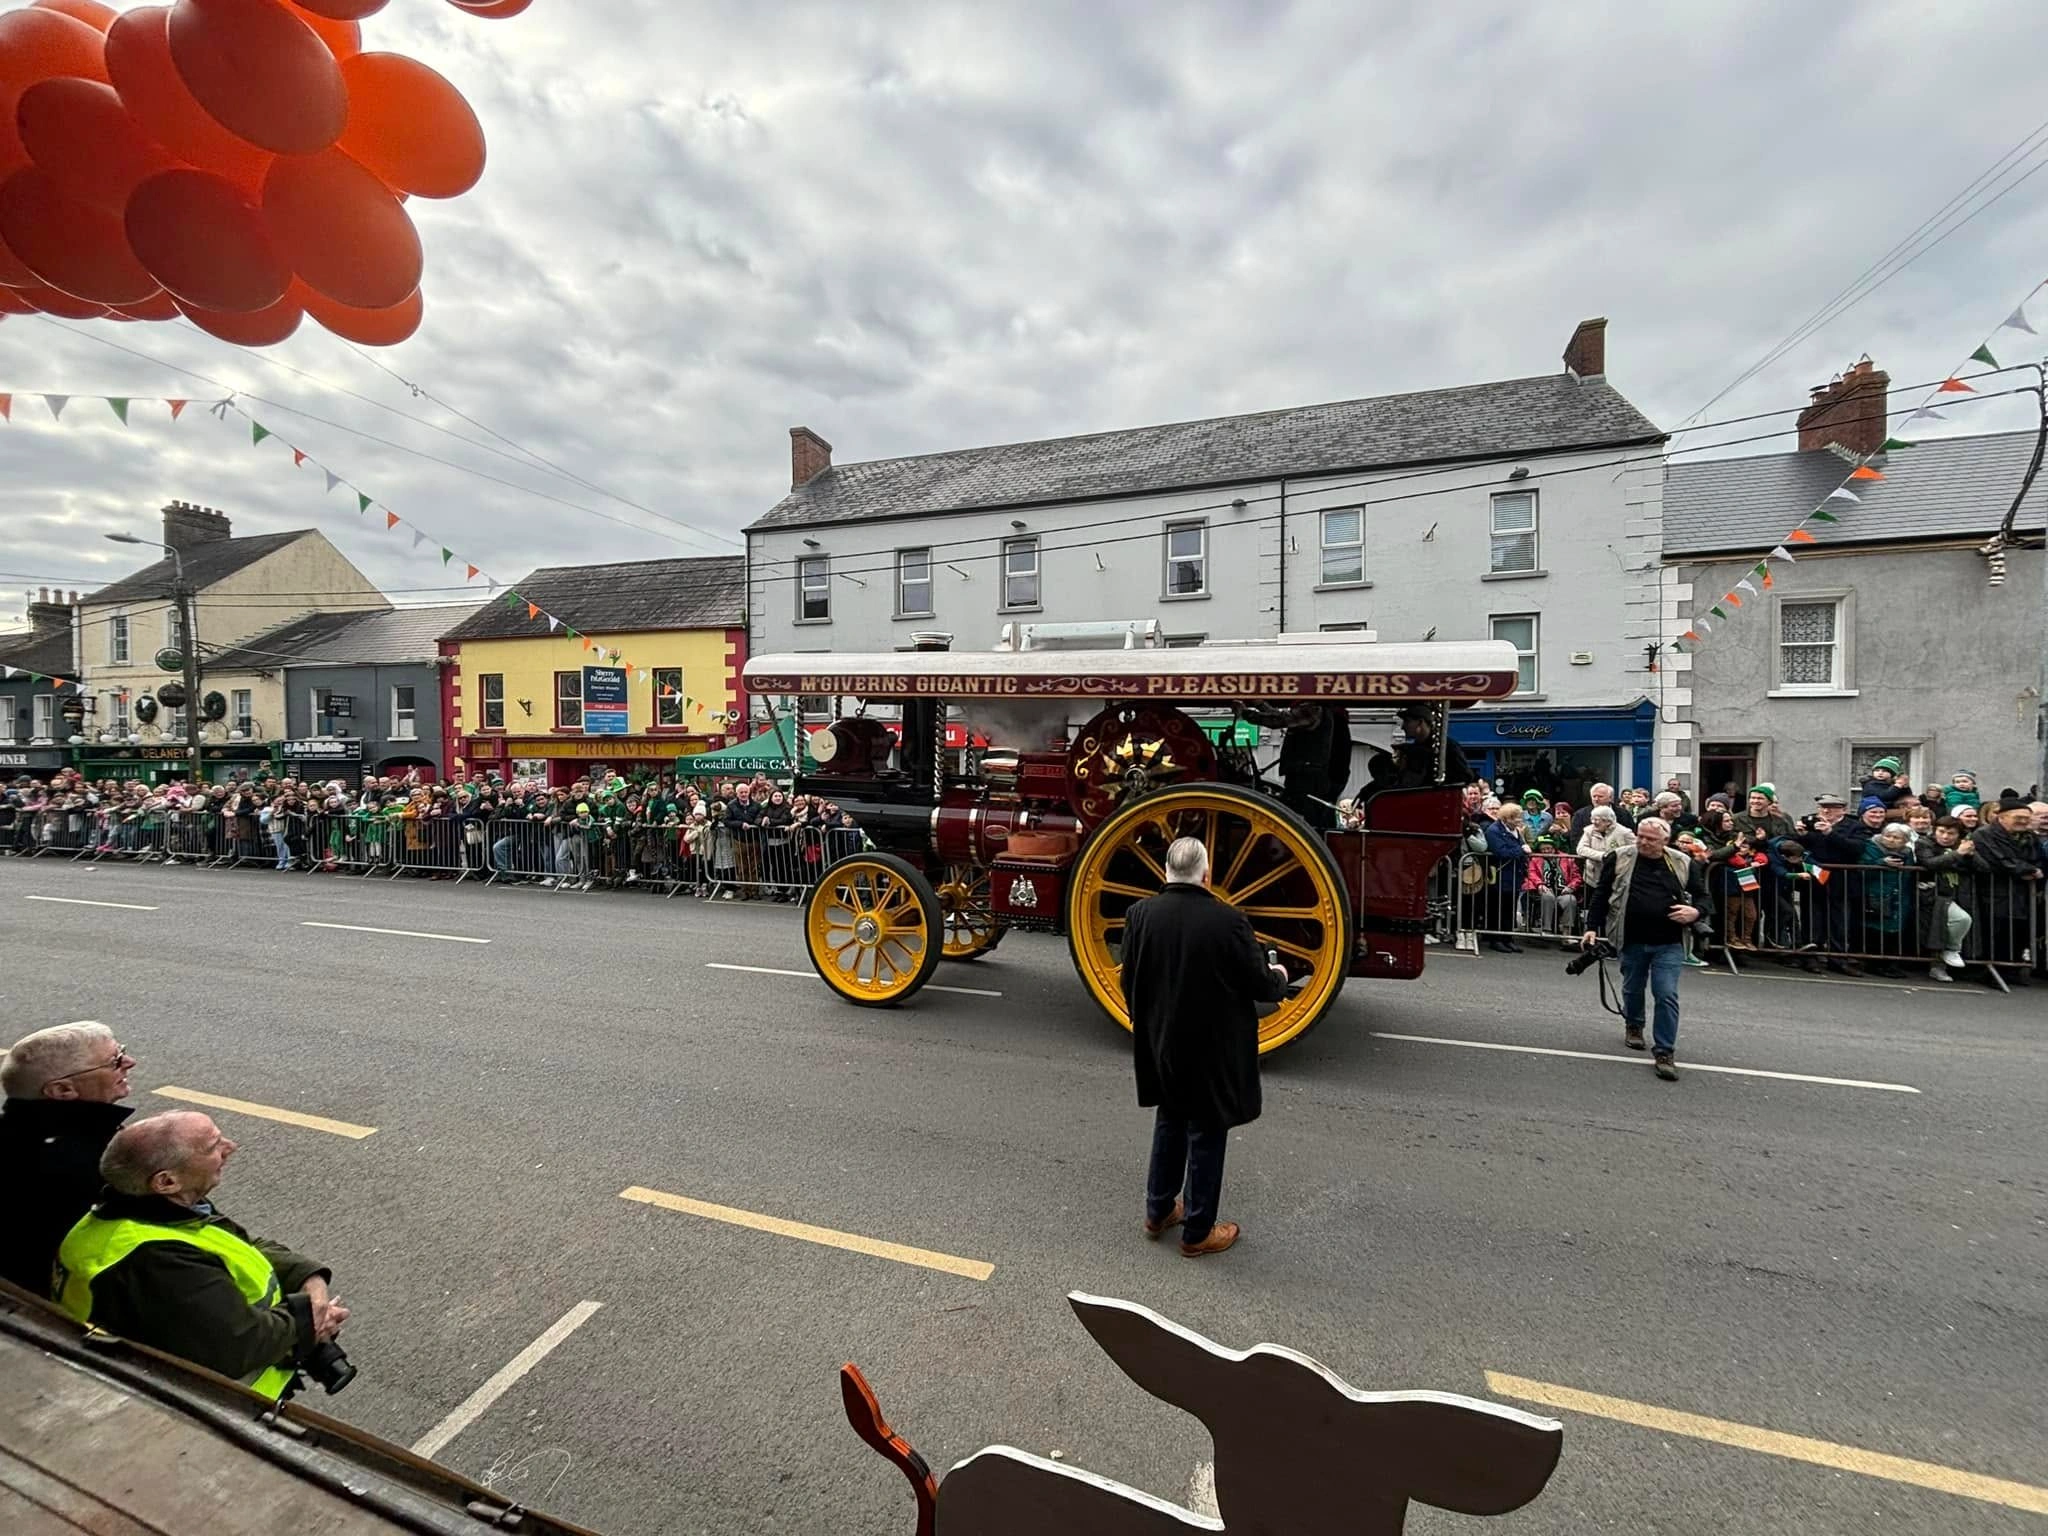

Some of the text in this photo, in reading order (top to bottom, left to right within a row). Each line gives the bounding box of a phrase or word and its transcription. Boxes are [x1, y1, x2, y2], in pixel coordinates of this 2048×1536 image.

[916, 676, 1017, 693] GIGANTIC
[1146, 675, 1411, 694] PLEASURE FAIRS
[1496, 721, 1553, 740] Escape
[576, 742, 662, 755] PRICEWISE
[0, 753, 28, 765] INER
[693, 758, 736, 769] Cootehill
[739, 758, 767, 769] Celtic
